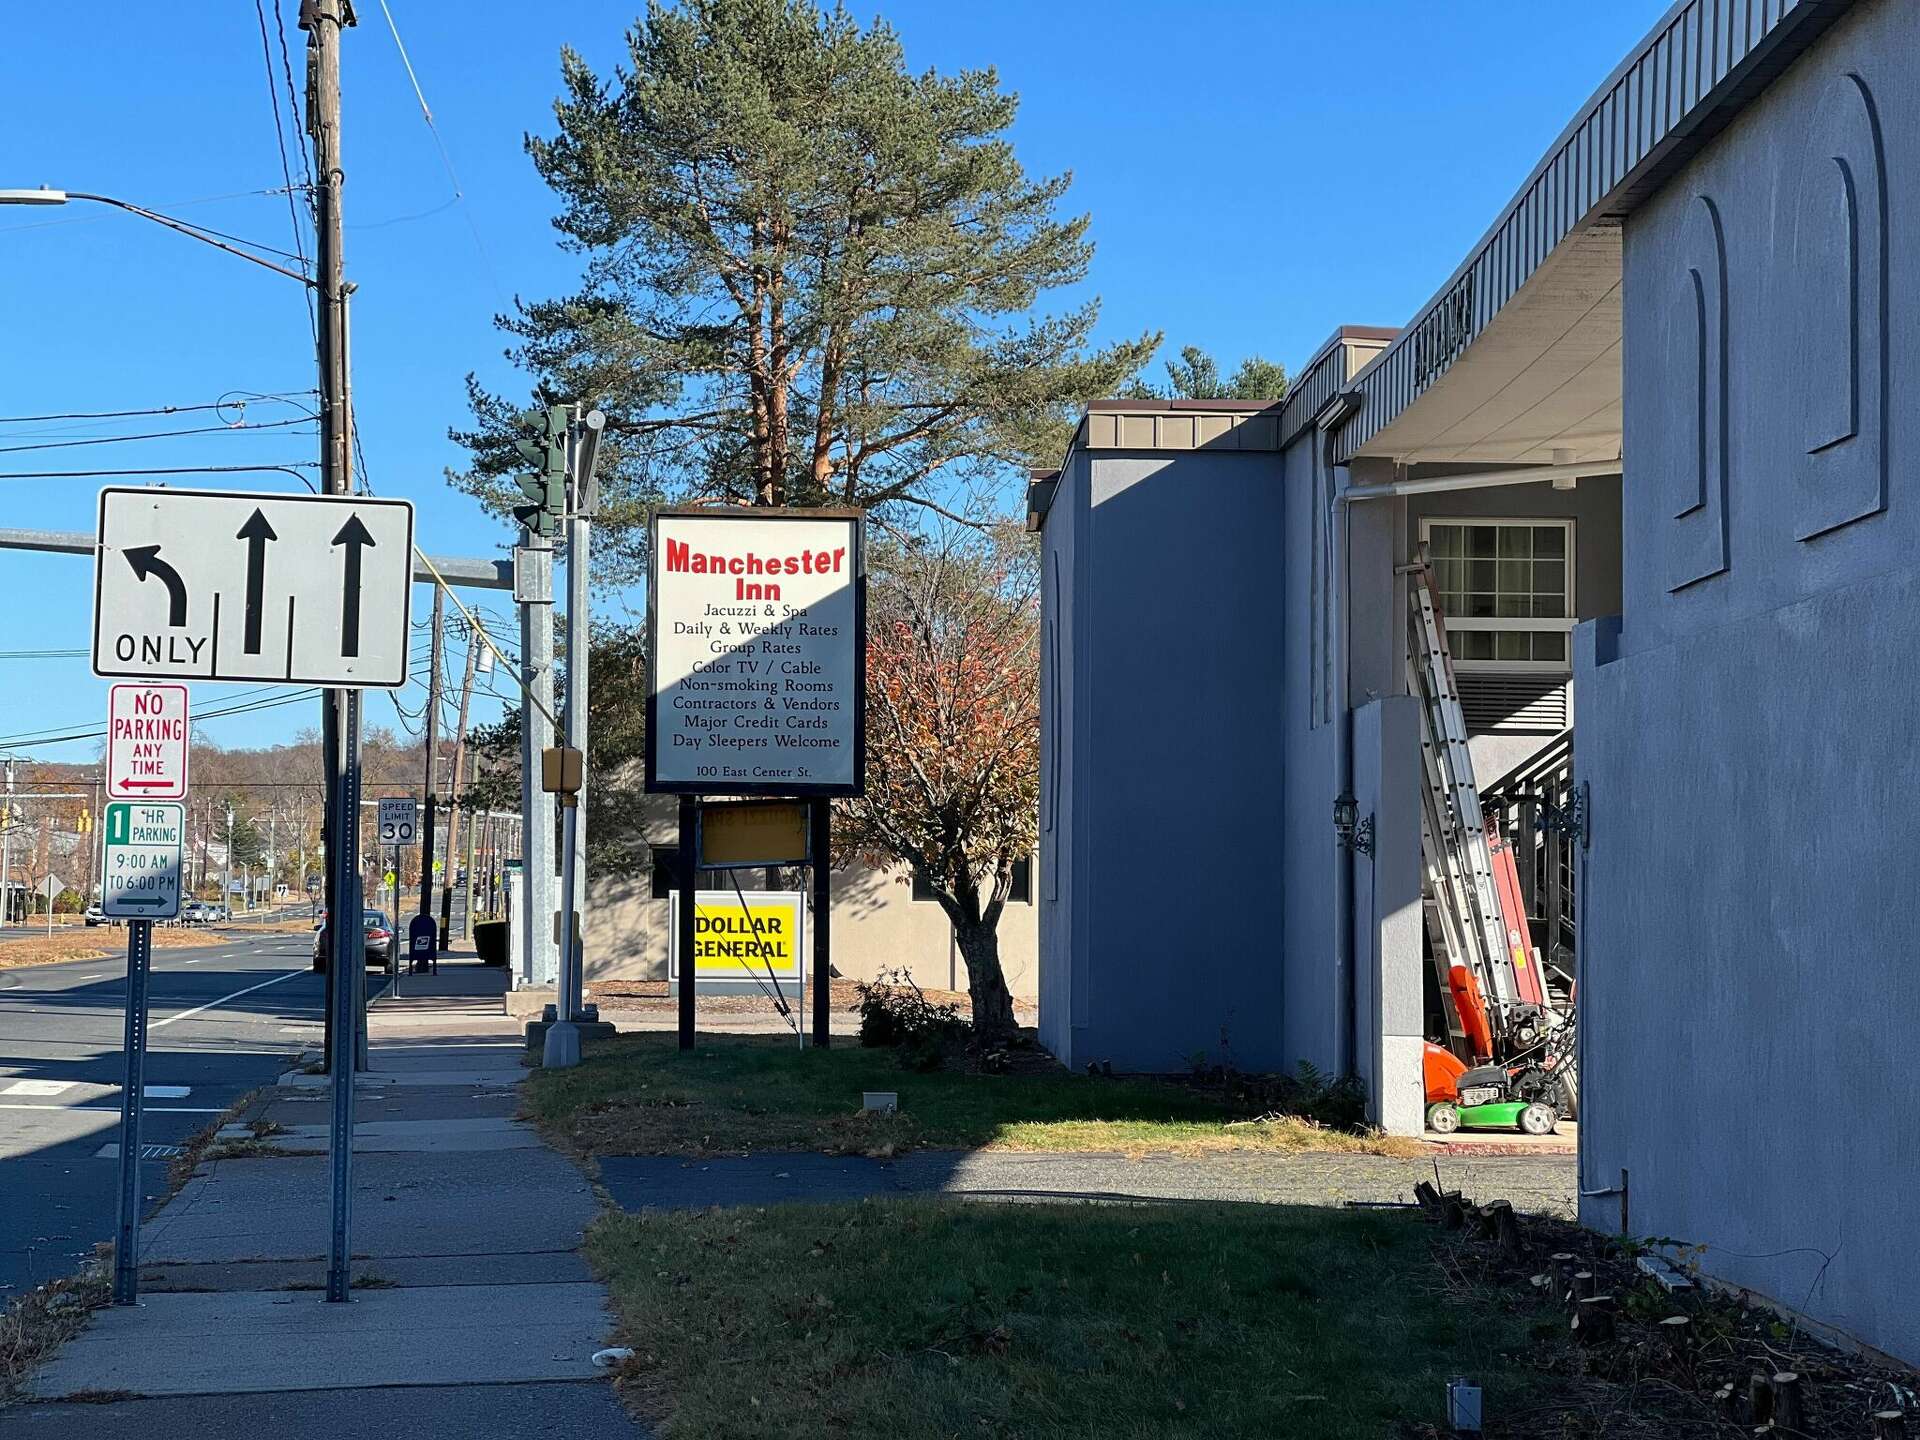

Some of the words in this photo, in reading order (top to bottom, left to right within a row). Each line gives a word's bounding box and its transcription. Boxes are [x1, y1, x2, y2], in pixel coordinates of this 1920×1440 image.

[666, 537, 845, 575] Manchester
[736, 578, 780, 601] Inn
[704, 604, 757, 617] Jacuzzi
[764, 605, 776, 617] &
[783, 605, 808, 621] Spa
[674, 622, 712, 637] Daily
[720, 623, 731, 635] &
[739, 623, 792, 638] Weekly
[799, 624, 838, 636] Rates
[115, 634, 207, 664] ONLY
[710, 641, 756, 657] Group
[762, 642, 801, 654] Rates
[692, 661, 731, 674] Color
[737, 661, 759, 674] TV
[781, 661, 822, 674] Cable
[680, 678, 778, 695] Non-smoking
[785, 679, 833, 692] Rooms
[135, 694, 163, 715] NO
[673, 696, 757, 710] Contractors
[764, 697, 776, 710] &
[784, 698, 840, 711] Vendors
[115, 719, 181, 741] PARKING
[684, 714, 727, 731] Major
[734, 715, 779, 728] Credit
[786, 715, 828, 729] Cards
[673, 734, 701, 750] Day
[708, 734, 767, 750] Sleepers
[774, 735, 840, 748] Welcome
[133, 744, 163, 758] ANY
[131, 761, 164, 775] TIME
[697, 766, 717, 777] 100
[723, 766, 747, 777] East
[752, 767, 793, 777] Center
[797, 767, 812, 777] St.
[382, 803, 413, 811] SPEED
[385, 812, 410, 820] LIMIT
[113, 810, 123, 839] 1
[145, 810, 164, 824] HR
[383, 823, 412, 840] 30
[132, 828, 177, 842] PARKING
[117, 854, 146, 869] 9:00
[151, 855, 168, 869] AM
[109, 876, 123, 889] TO
[126, 876, 154, 890] 6:00
[159, 876, 175, 891] PM
[695, 917, 782, 934] DOLLAR
